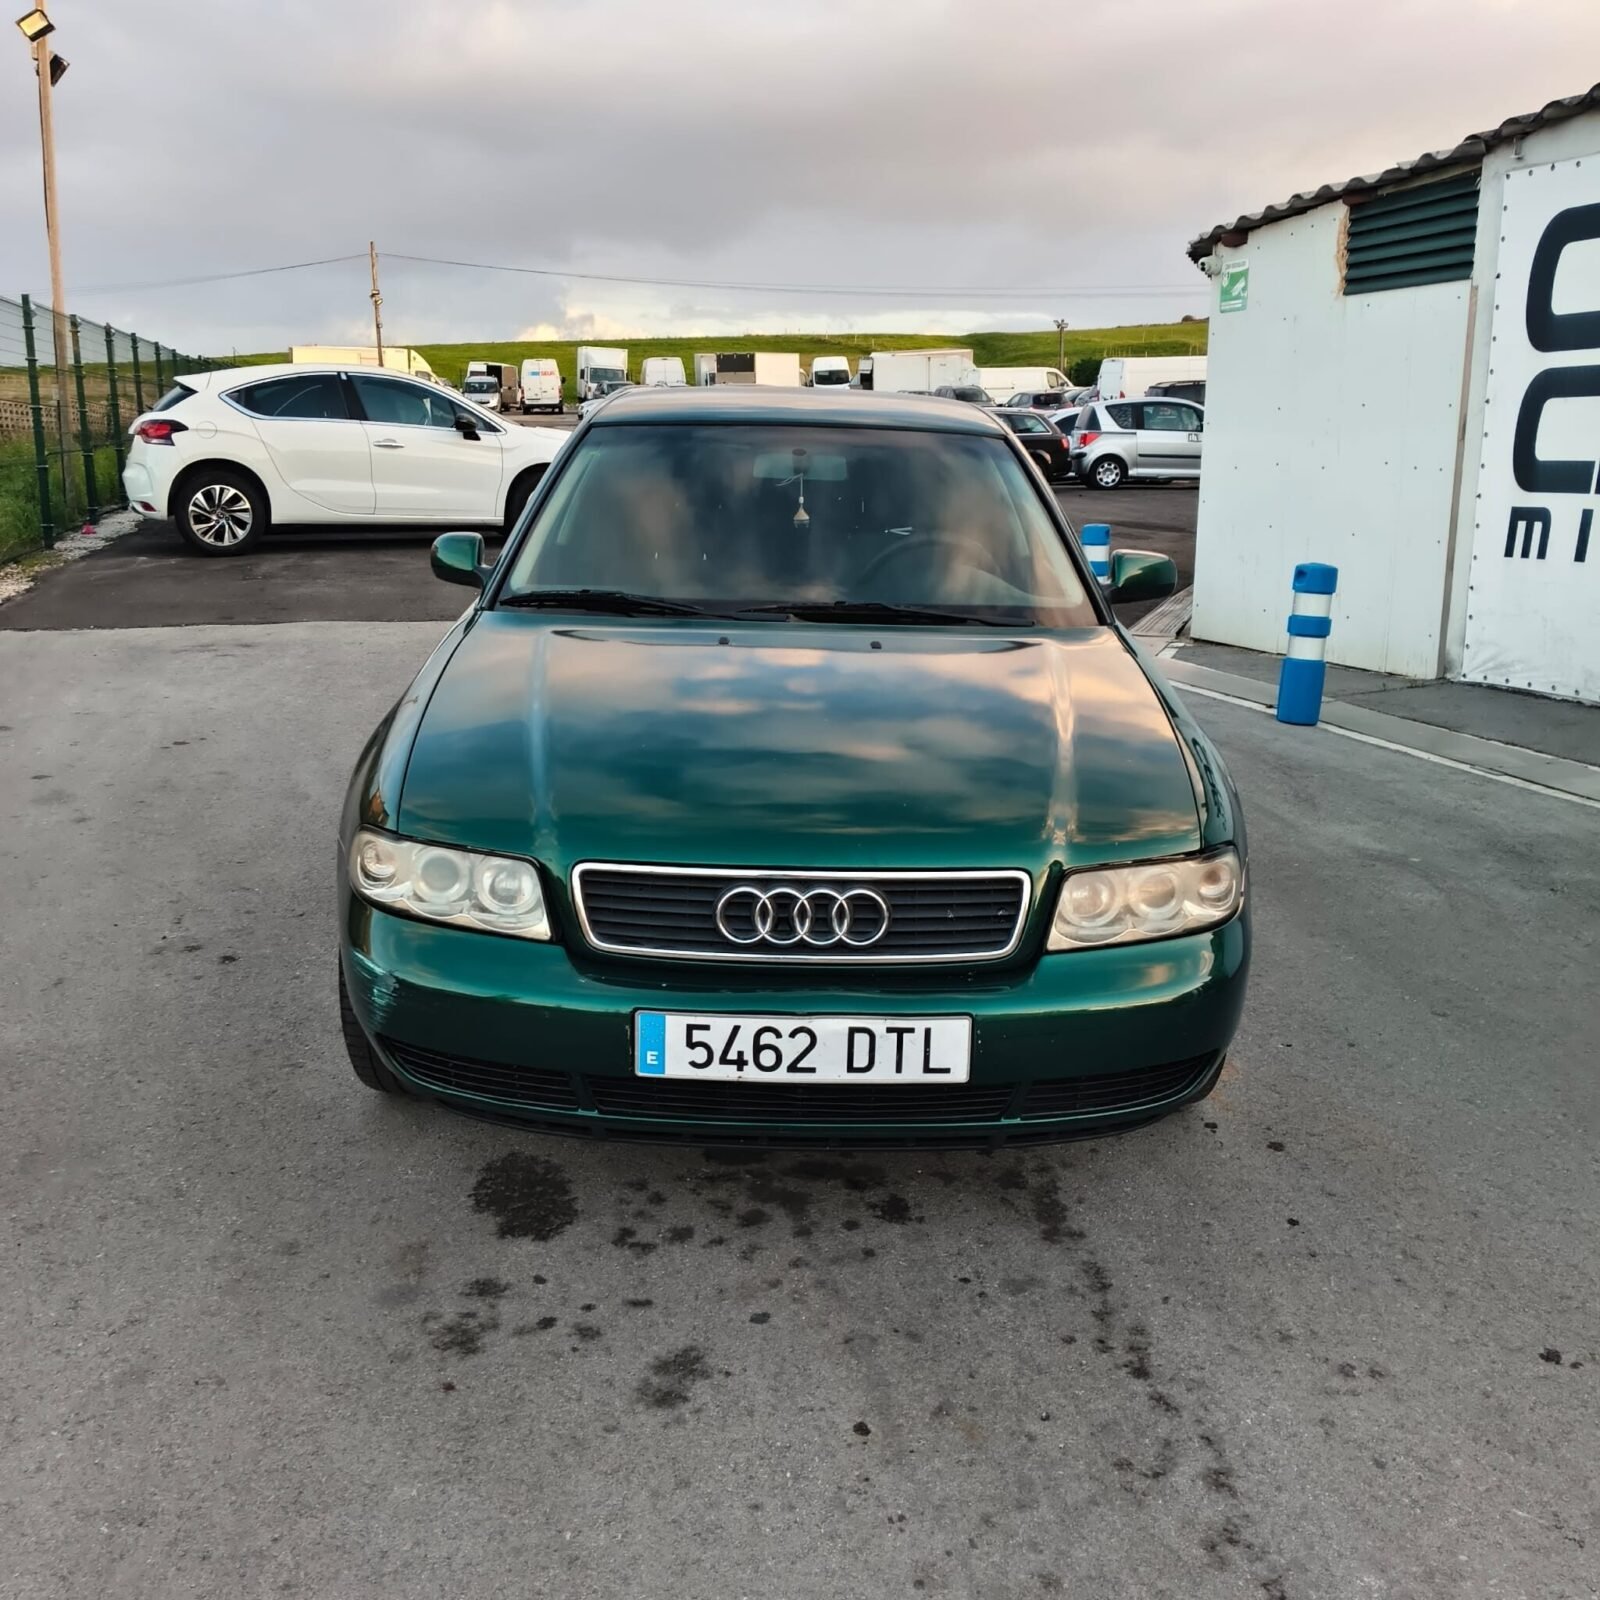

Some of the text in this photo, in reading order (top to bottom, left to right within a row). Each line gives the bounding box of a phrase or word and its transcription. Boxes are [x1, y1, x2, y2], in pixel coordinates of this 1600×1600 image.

[647, 1051, 658, 1064] E
[686, 1024, 951, 1074] 5462 DTL
